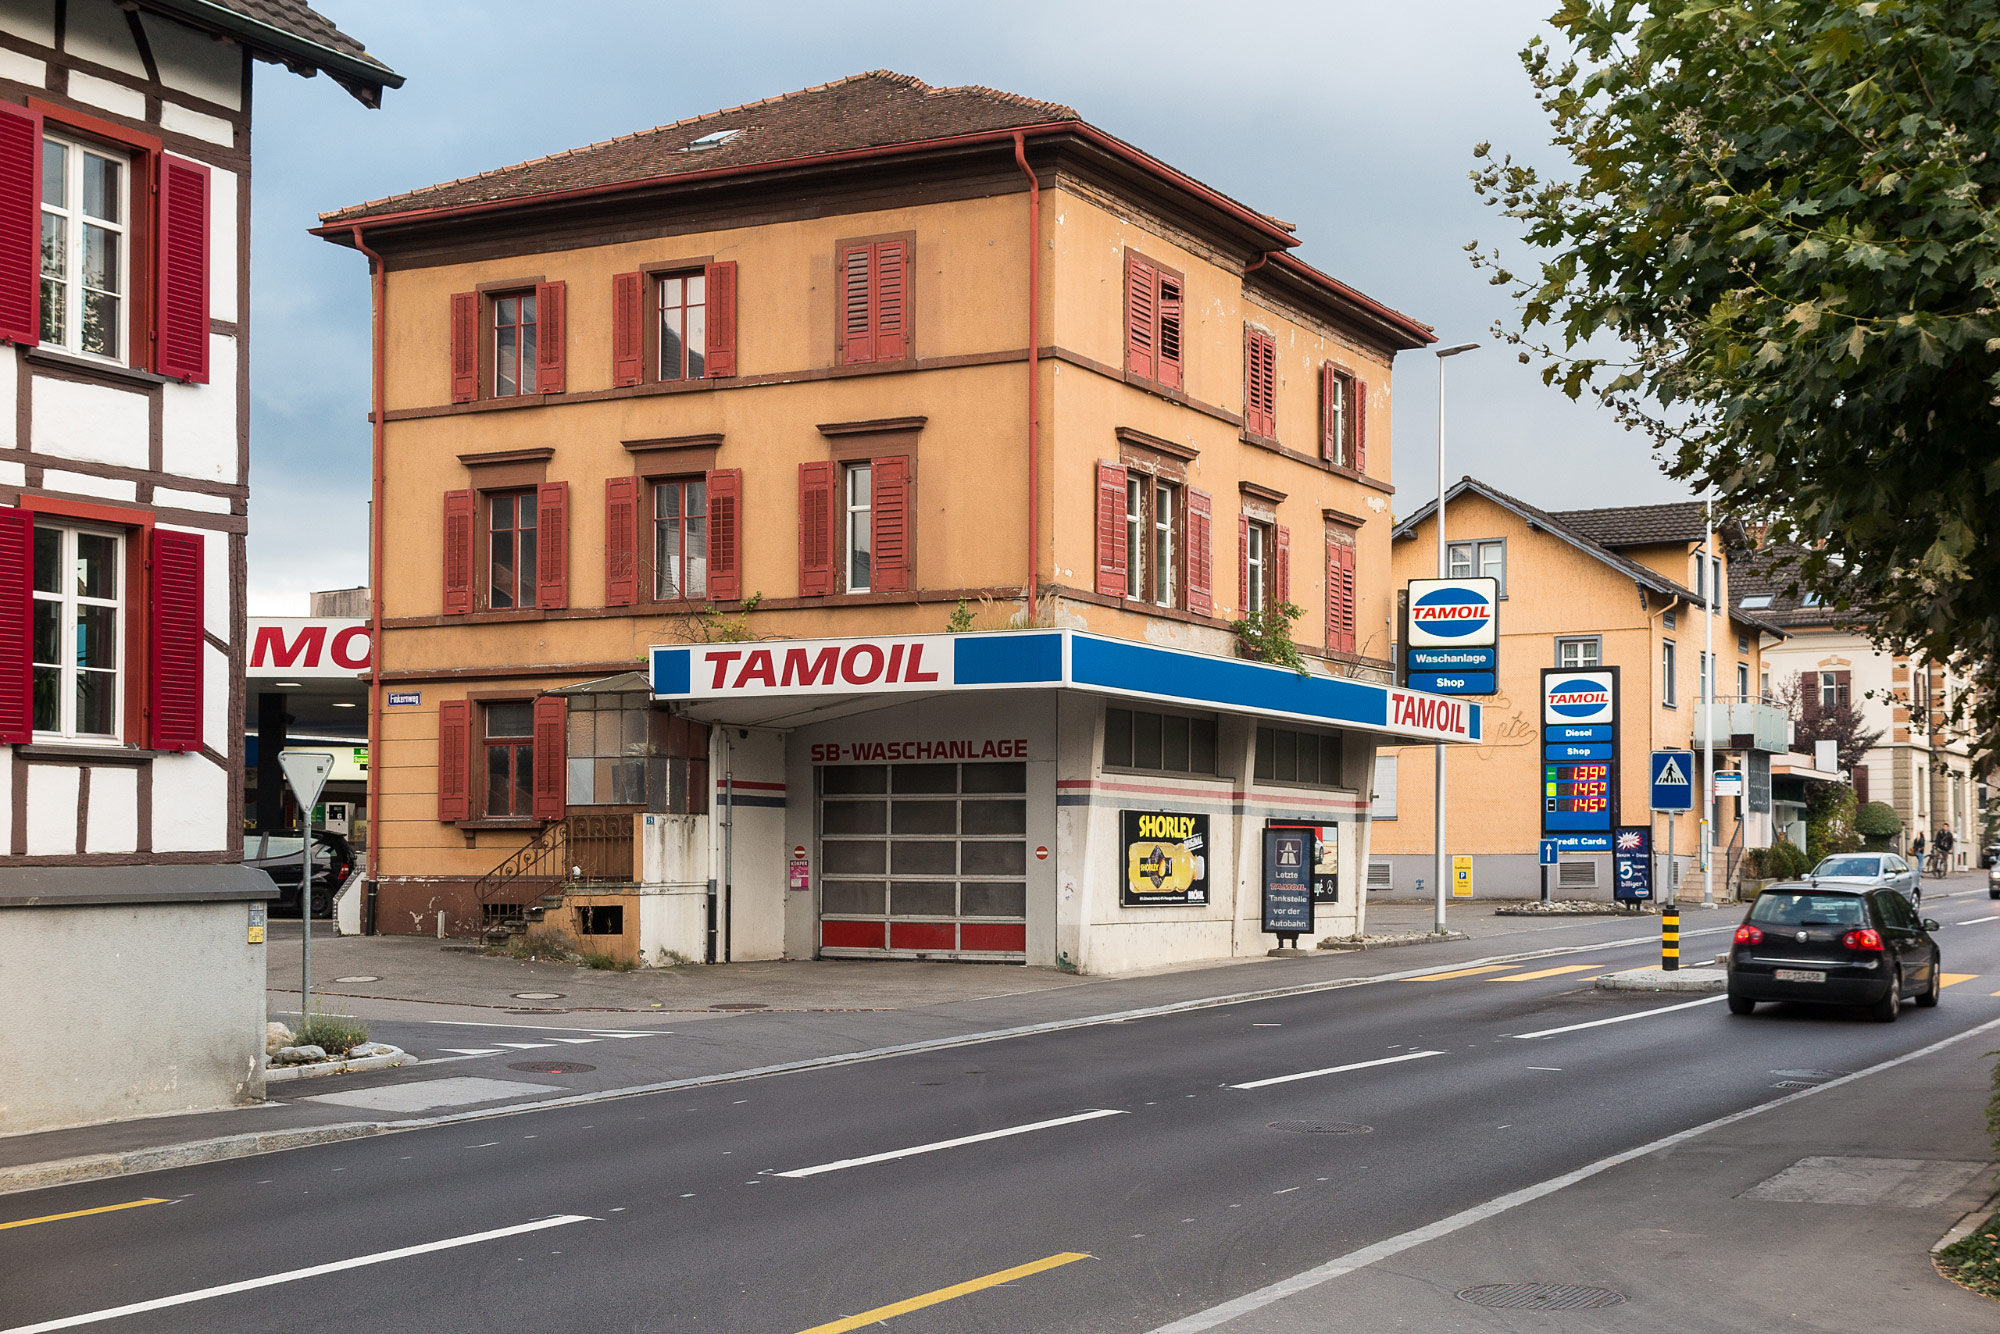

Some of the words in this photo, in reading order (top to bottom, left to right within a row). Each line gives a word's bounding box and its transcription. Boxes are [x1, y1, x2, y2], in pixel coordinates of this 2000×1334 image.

[1413, 606, 1490, 619] TAMOIL
[1416, 654, 1487, 664] Waschanlage
[704, 643, 939, 690] TAMOIL
[1437, 678, 1464, 688] Shop
[1548, 693, 1609, 704] TAMOIL
[1392, 693, 1465, 733] TAMOIL
[1565, 729, 1592, 737] Diesel
[811, 739, 1027, 761] SB-WASCHANLAGE
[1567, 748, 1590, 756] Shop
[1138, 815, 1196, 838] SHORLEY
[1620, 861, 1633, 879] 5
[1270, 883, 1306, 891] TAMOIL
